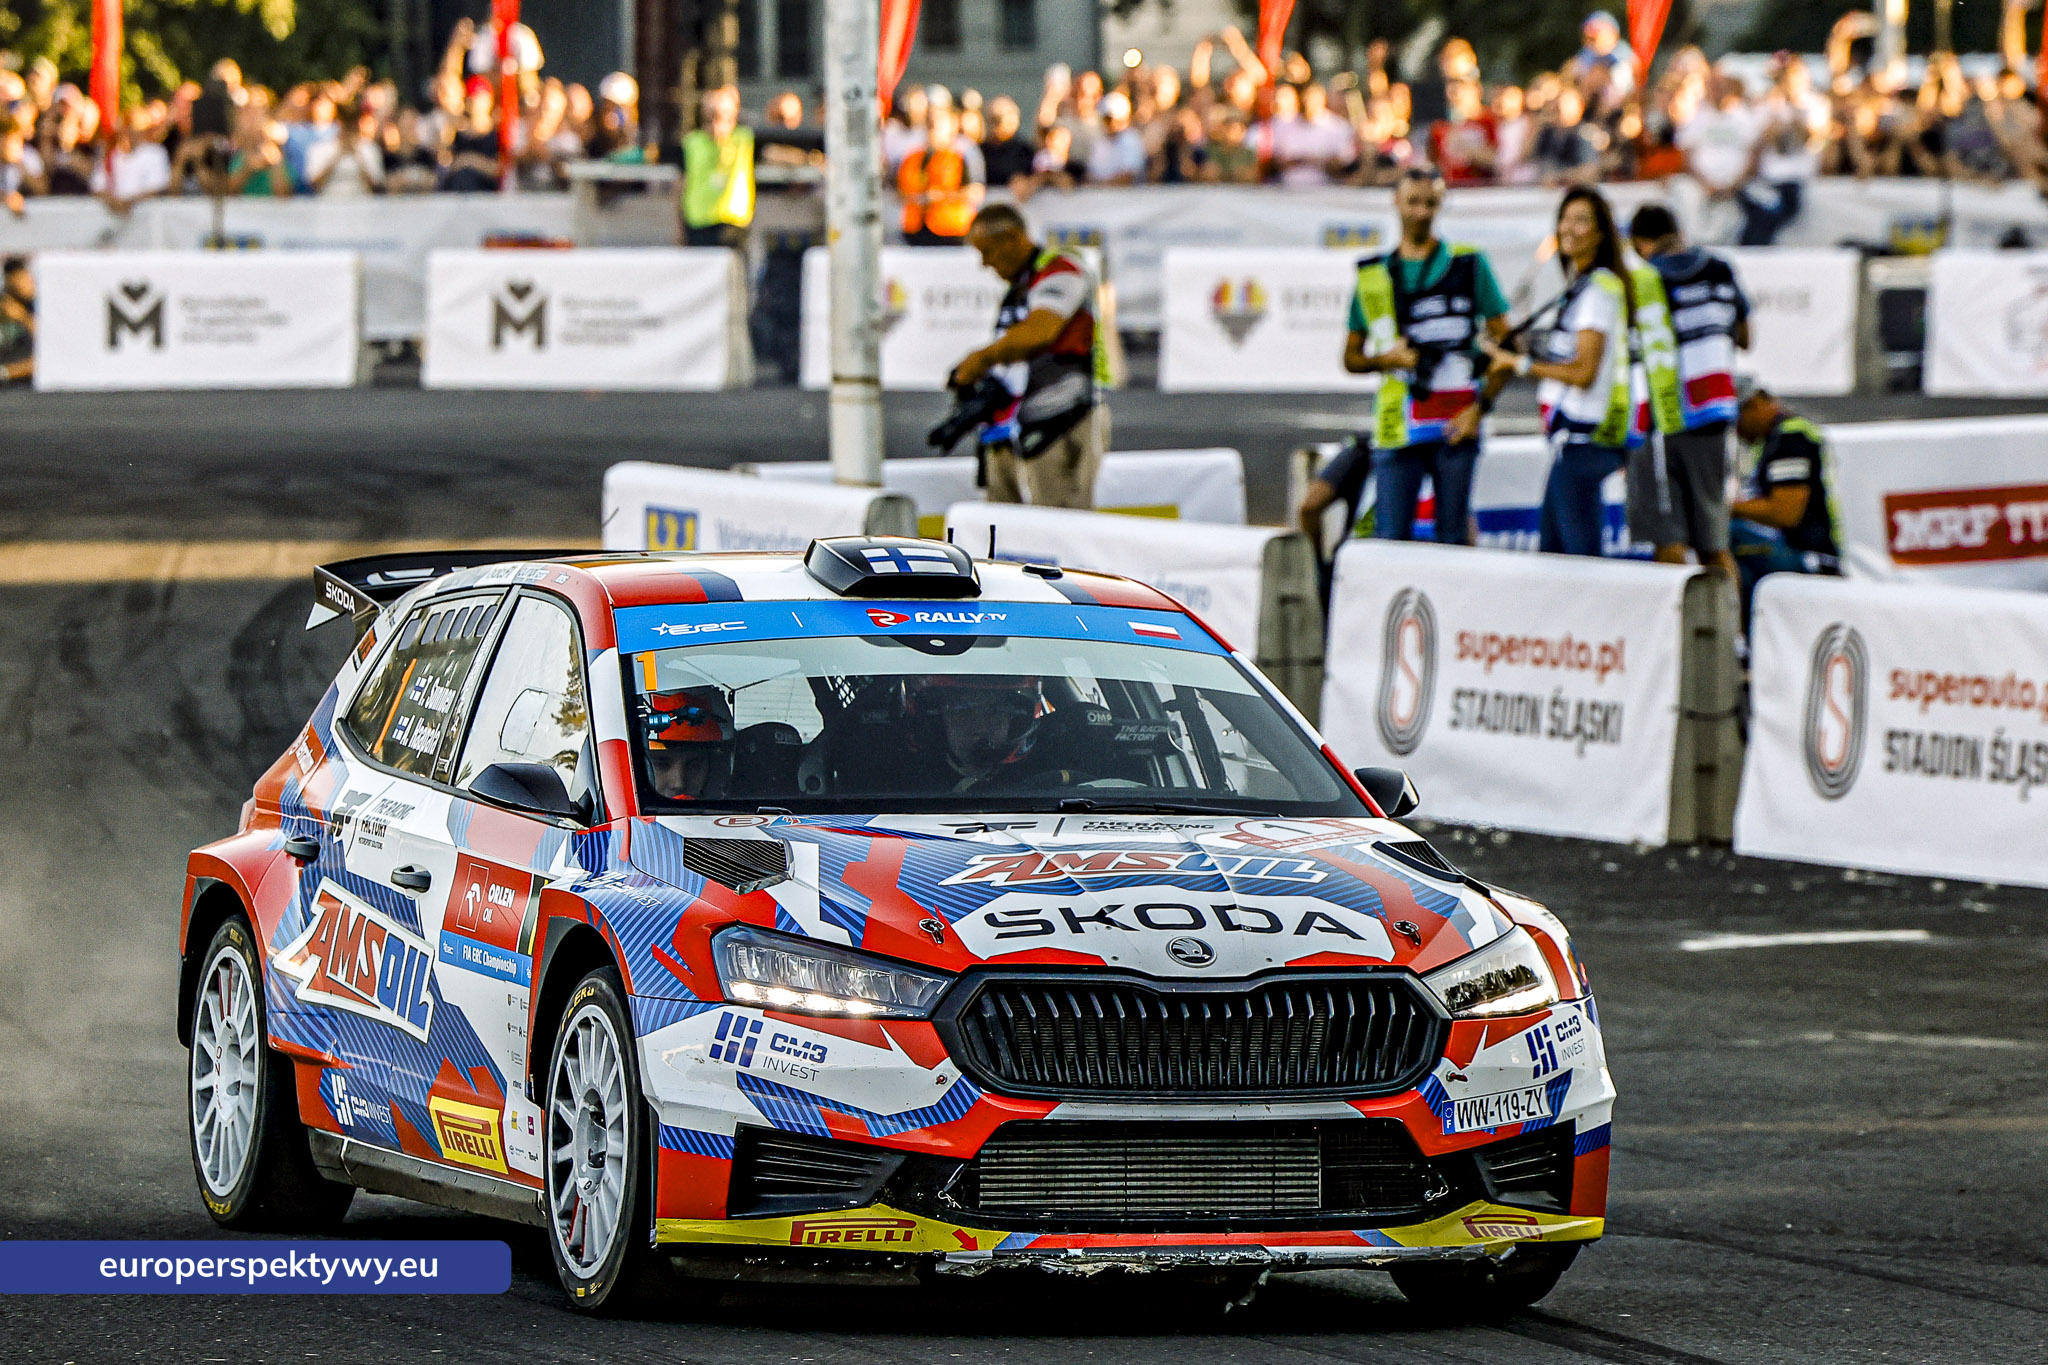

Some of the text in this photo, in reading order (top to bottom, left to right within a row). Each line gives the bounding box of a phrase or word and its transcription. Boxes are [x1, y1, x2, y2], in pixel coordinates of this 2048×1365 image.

[325, 580, 356, 614] SKODA
[636, 650, 658, 691] 1
[1453, 629, 1626, 683] superauto.pl
[1450, 684, 1624, 759] STADION ŚLĄSKI
[1883, 728, 1983, 779] STADION
[966, 851, 1321, 882] AMSOIL
[487, 883, 516, 909] ORLEN
[482, 907, 494, 924] OIL
[984, 903, 1367, 941] SKODA
[288, 889, 430, 1033] AMSOIL
[462, 944, 472, 961] FIA
[1555, 1014, 1582, 1042] CM3
[769, 1032, 829, 1064] CM3
[1561, 1038, 1586, 1062] INVEST
[762, 1055, 820, 1082] INVEST
[1457, 1087, 1544, 1130] WW-119-ZY
[435, 1109, 498, 1161] PIRELLI
[789, 1217, 917, 1246] PIRELLI
[1460, 1213, 1544, 1241] PIRELLI
